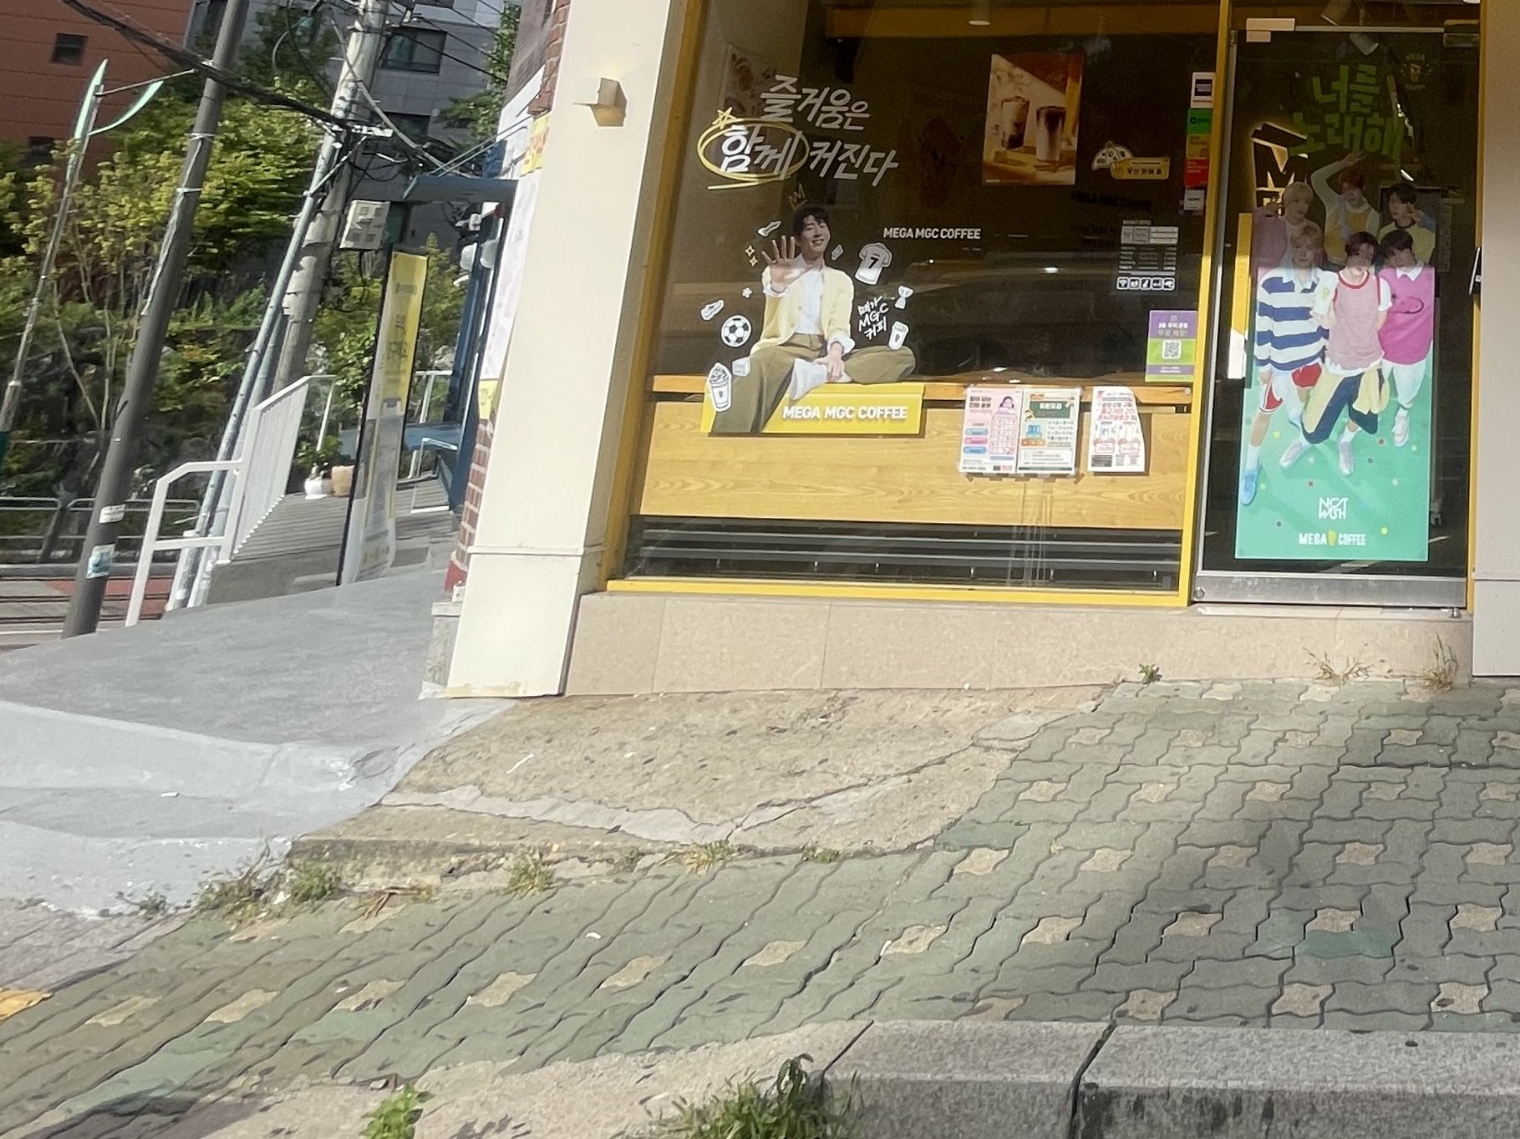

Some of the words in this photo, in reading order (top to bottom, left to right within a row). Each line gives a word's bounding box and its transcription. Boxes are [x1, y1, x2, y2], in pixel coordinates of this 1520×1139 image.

[760, 74, 870, 131] 즐거움은
[720, 124, 803, 181] 함께
[810, 140, 899, 187] 커진다
[883, 227, 913, 238] MEGA
[915, 228, 939, 239] MGC
[940, 228, 981, 239] COFFEE
[859, 303, 889, 331] MGC
[864, 316, 887, 340] 커피
[783, 406, 821, 419] MEGA
[825, 406, 856, 419] MGC
[858, 406, 908, 420] COFFEE
[1298, 532, 1328, 546] MEGA
[1338, 533, 1367, 547] COFFEE
